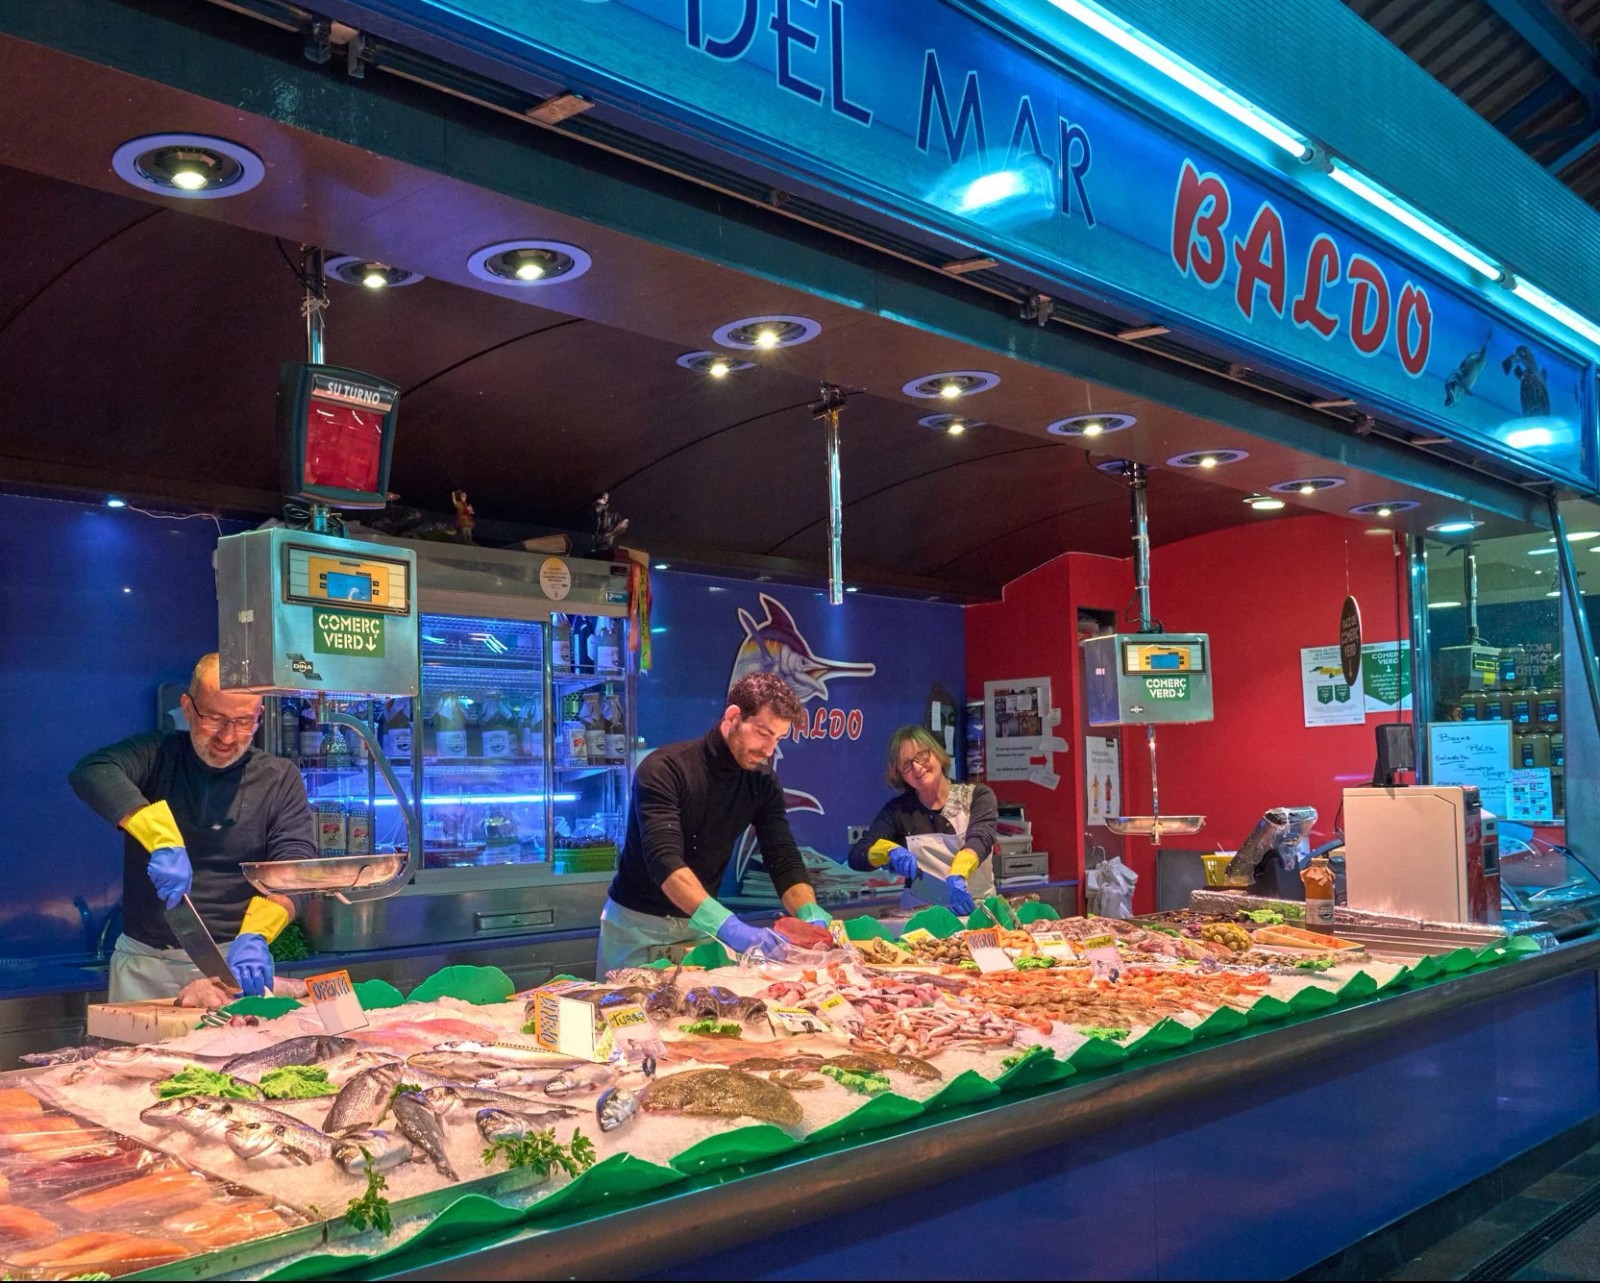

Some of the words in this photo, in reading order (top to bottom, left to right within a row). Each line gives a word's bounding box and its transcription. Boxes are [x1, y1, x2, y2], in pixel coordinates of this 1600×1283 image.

[917, 48, 1096, 229] MAR
[1170, 157, 1433, 379] BALDO
[326, 381, 342, 396] SU
[343, 385, 381, 405] TURNO
[318, 613, 380, 639] COMERÇ
[323, 631, 364, 650] VERD
[1145, 678, 1187, 690] COMERÇ
[1149, 688, 1176, 699] VERD
[779, 707, 864, 744] ALDO
[311, 975, 351, 1001] OFERTA
[539, 995, 559, 1045] OFERTA
